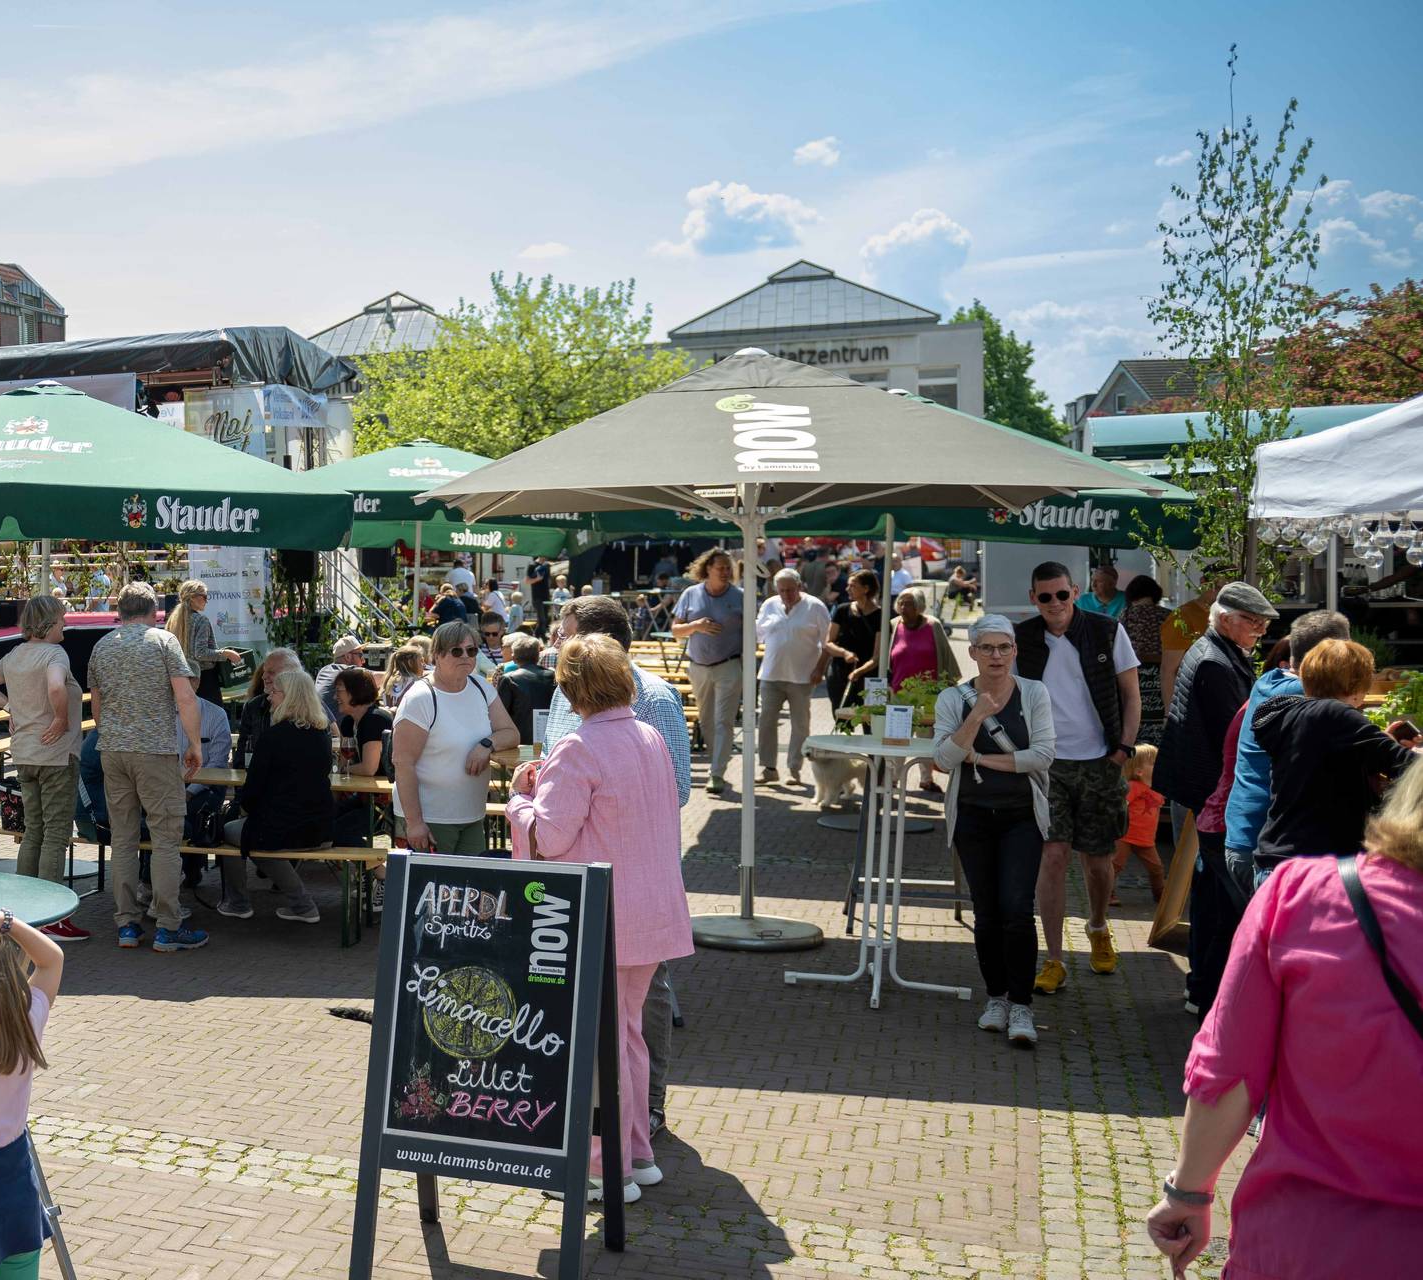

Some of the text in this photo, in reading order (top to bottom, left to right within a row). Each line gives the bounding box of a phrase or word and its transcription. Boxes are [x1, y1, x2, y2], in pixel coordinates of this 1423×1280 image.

[732, 402, 820, 473] now
[154, 495, 258, 534] Stauder
[424, 915, 492, 949] Spritz
[528, 891, 571, 976] now
[406, 962, 565, 1056] Limoncello
[446, 1090, 557, 1132] BERRY
[396, 1149, 552, 1179] www.lammsbraeu.de
